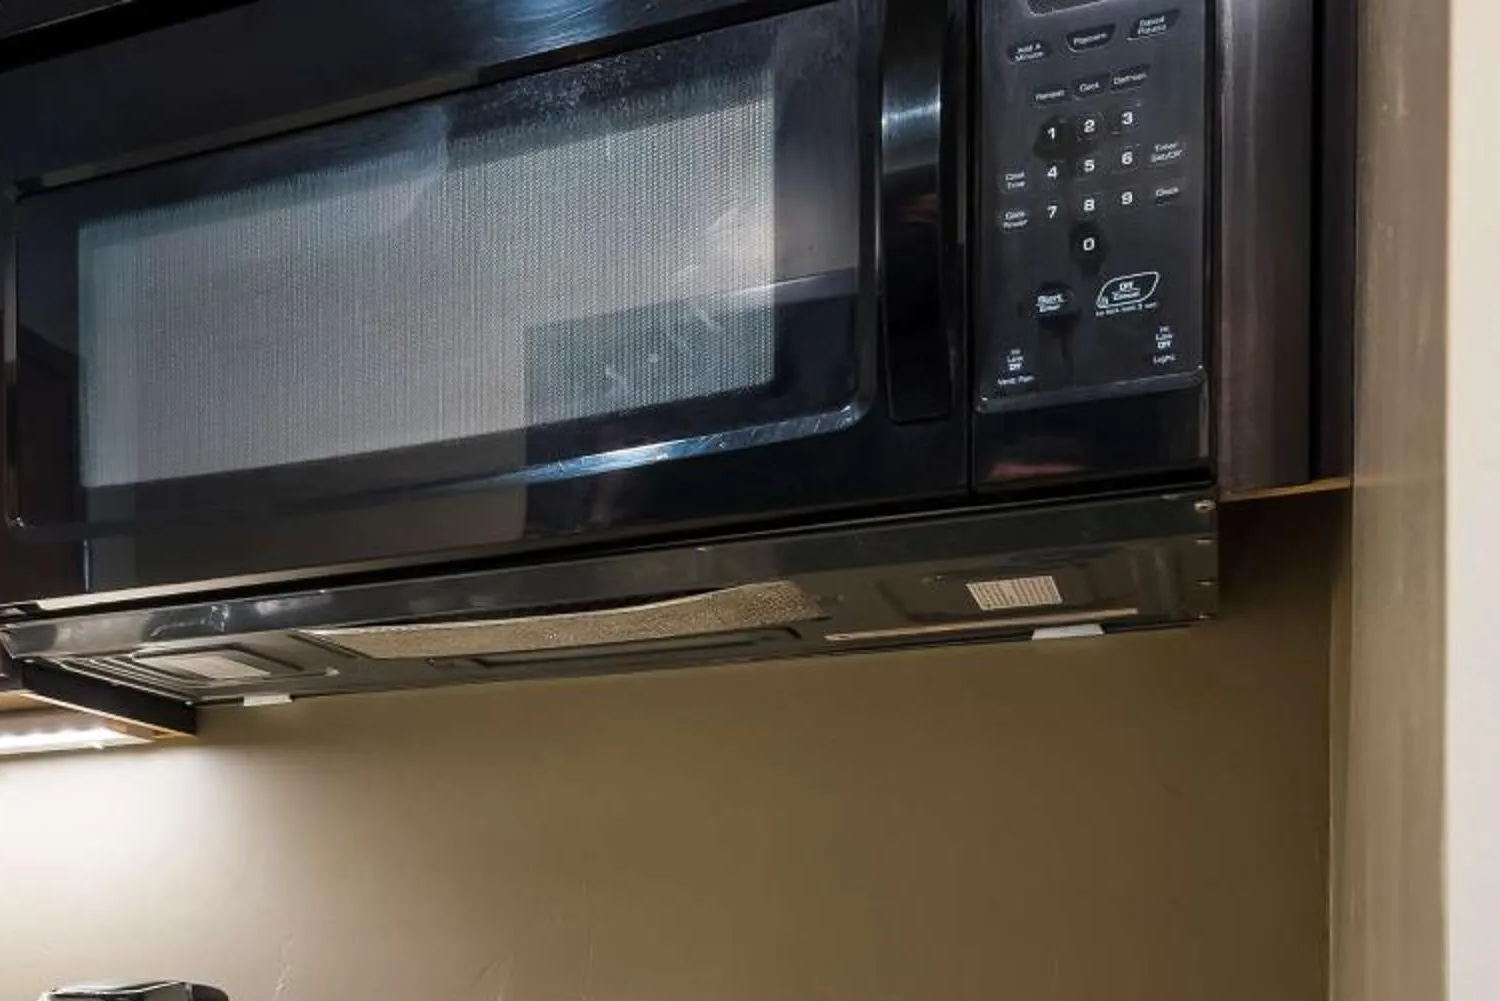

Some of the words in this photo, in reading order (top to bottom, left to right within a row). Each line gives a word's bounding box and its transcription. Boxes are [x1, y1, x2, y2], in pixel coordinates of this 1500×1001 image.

[1047, 127, 1056, 140] 1
[1084, 119, 1095, 133] 2
[1121, 112, 1133, 125] 3
[1047, 165, 1058, 179] 4
[1084, 159, 1095, 173] 5
[1121, 151, 1133, 165] 6
[1047, 205, 1058, 219] 7
[1084, 199, 1095, 212] 8
[1121, 191, 1133, 205] 9
[1083, 237, 1095, 250] 0
